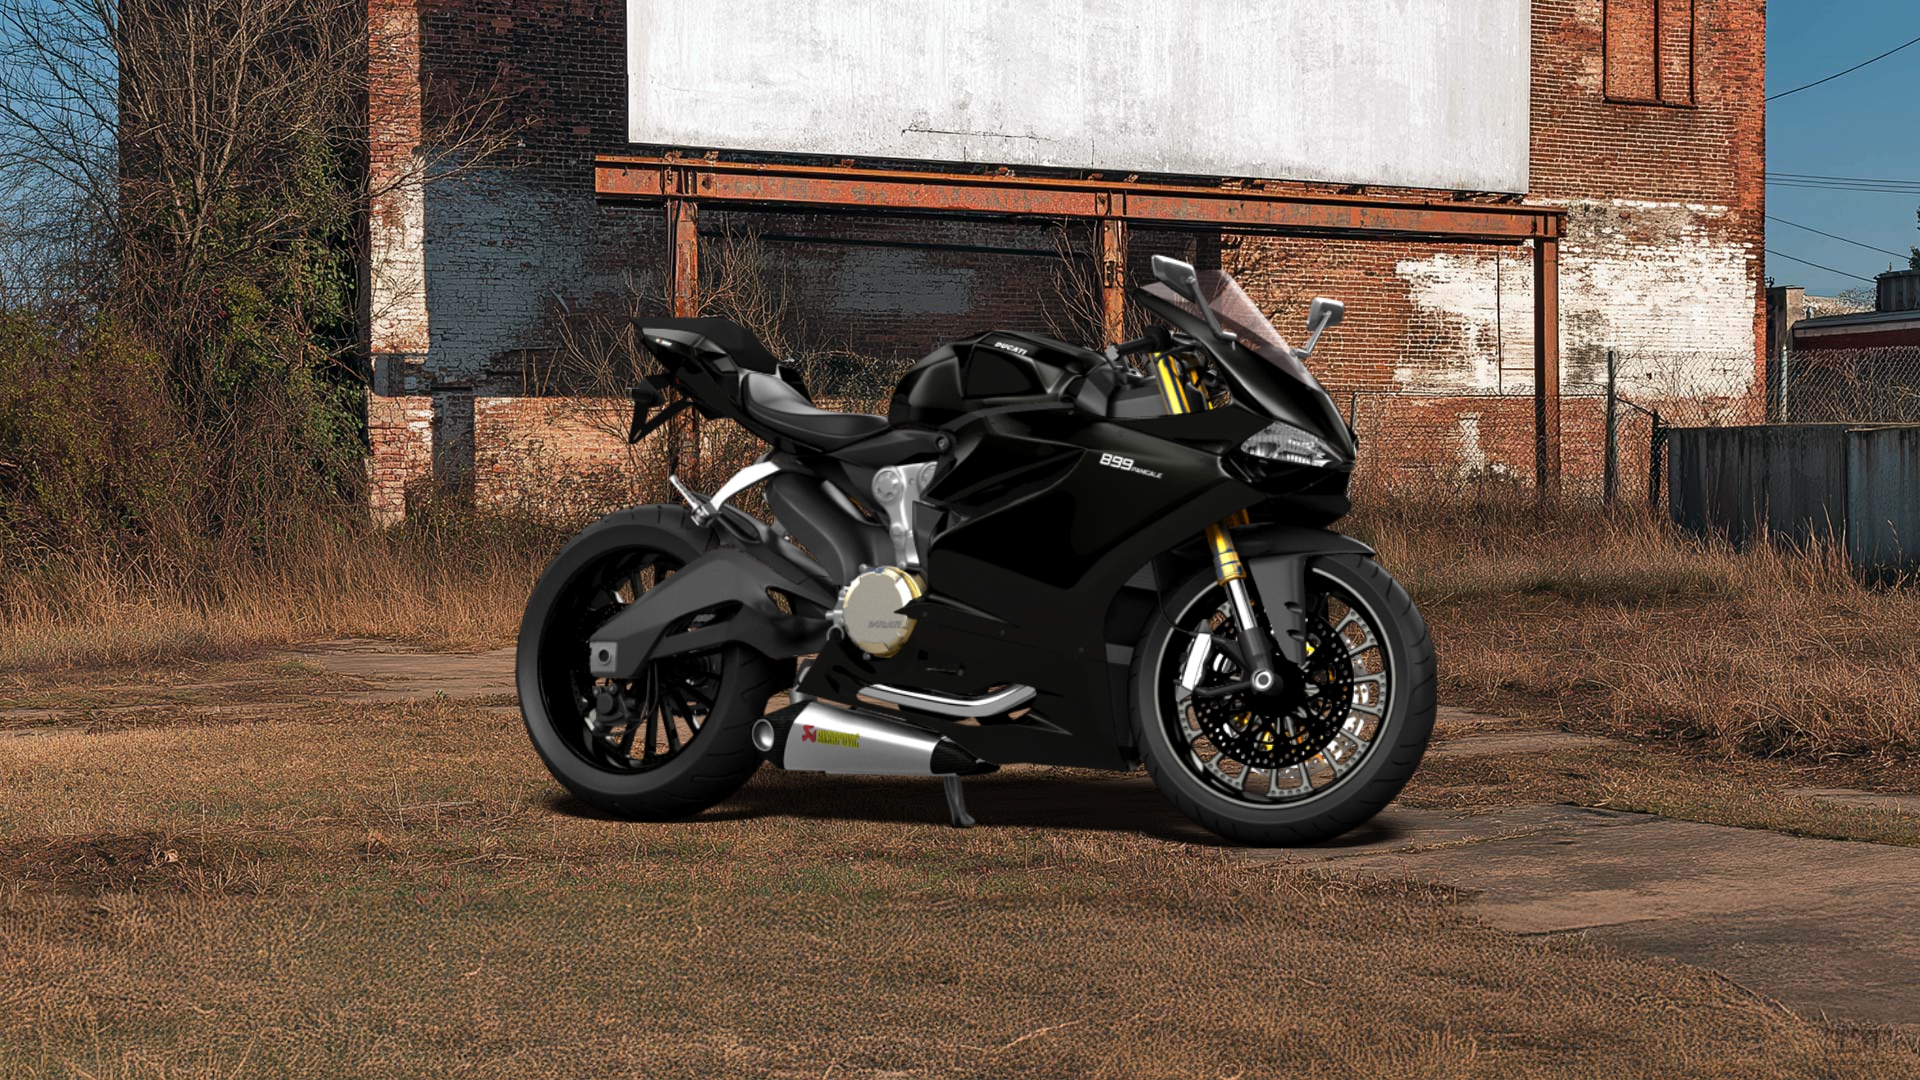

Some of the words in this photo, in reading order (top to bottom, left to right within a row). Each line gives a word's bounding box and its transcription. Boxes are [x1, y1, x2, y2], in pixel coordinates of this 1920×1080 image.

[994, 341, 1027, 355] DUCATI
[1099, 452, 1134, 471] 899
[867, 620, 902, 628] DUCATI
